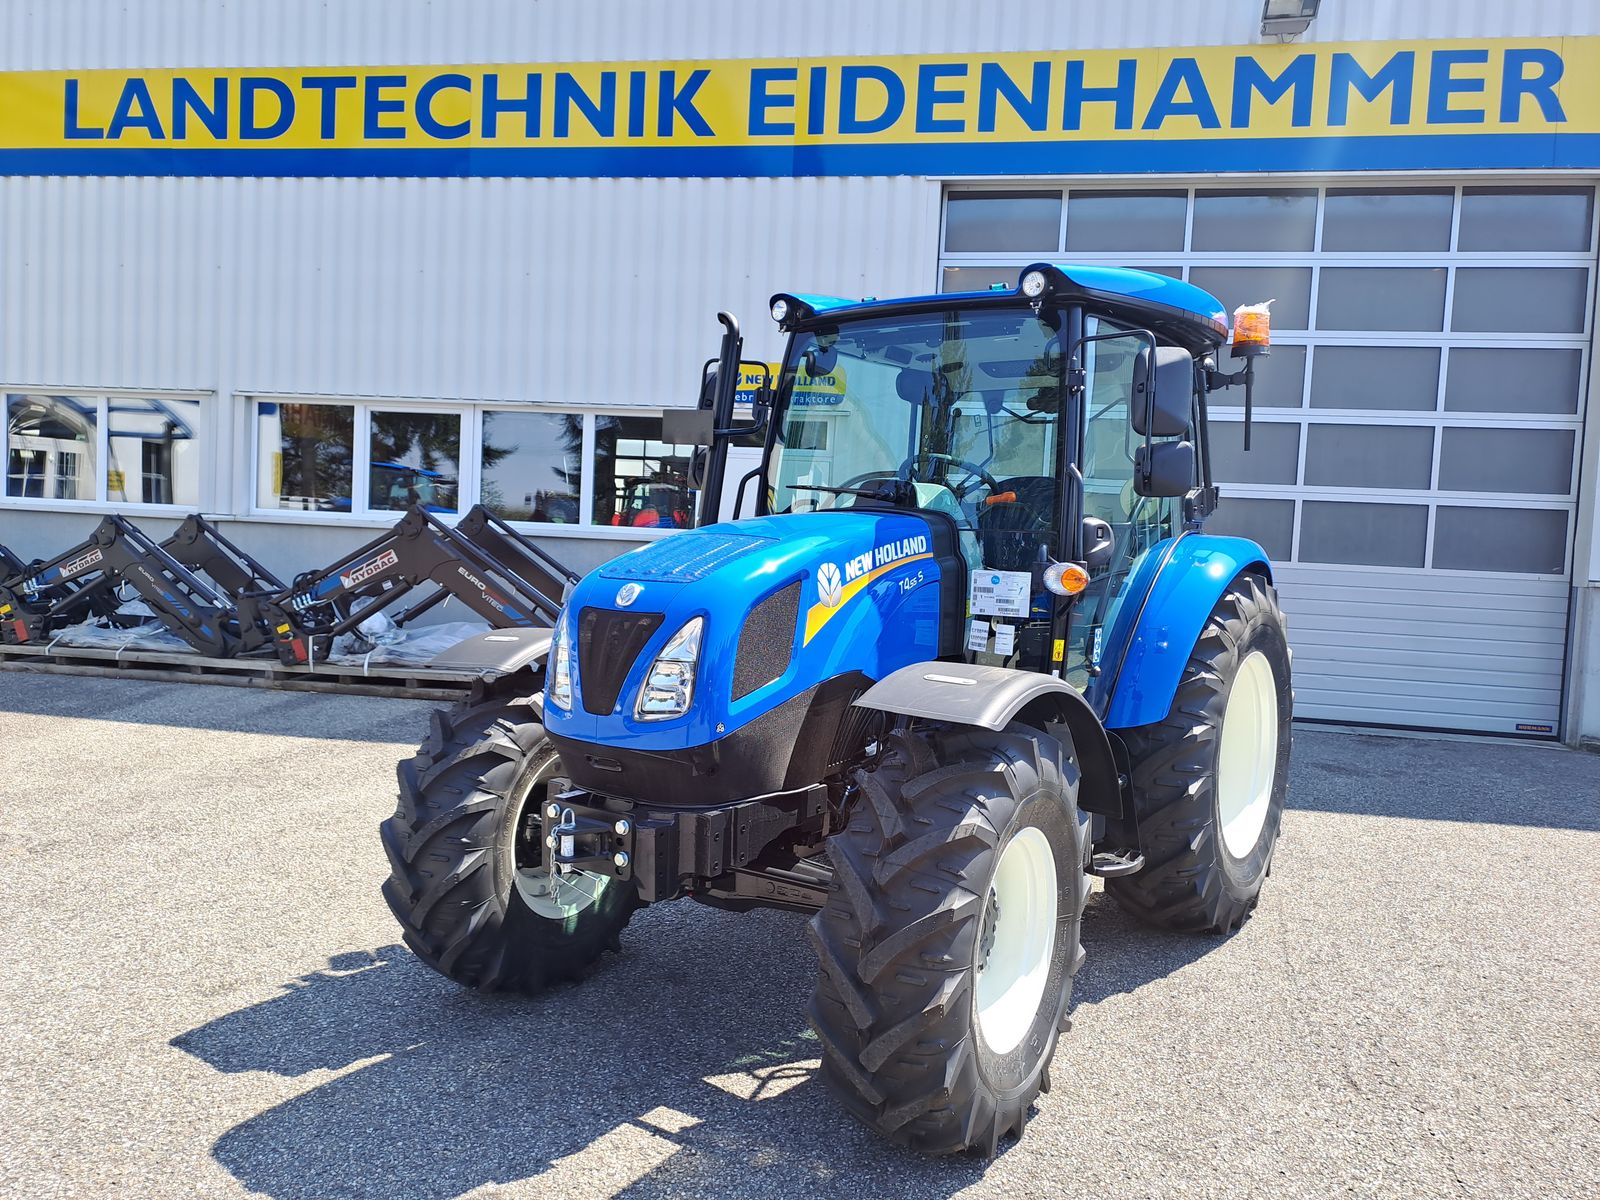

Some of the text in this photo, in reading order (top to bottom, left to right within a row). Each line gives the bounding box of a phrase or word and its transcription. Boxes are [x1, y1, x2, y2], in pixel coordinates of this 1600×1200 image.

[65, 48, 1567, 140] LANDTECHNIK EIDENHAMMER
[68, 554, 101, 575] HYDRAC
[351, 555, 396, 584] HYDRAC
[845, 535, 927, 582] NEW HOLLAND
[457, 566, 487, 591] EURO
